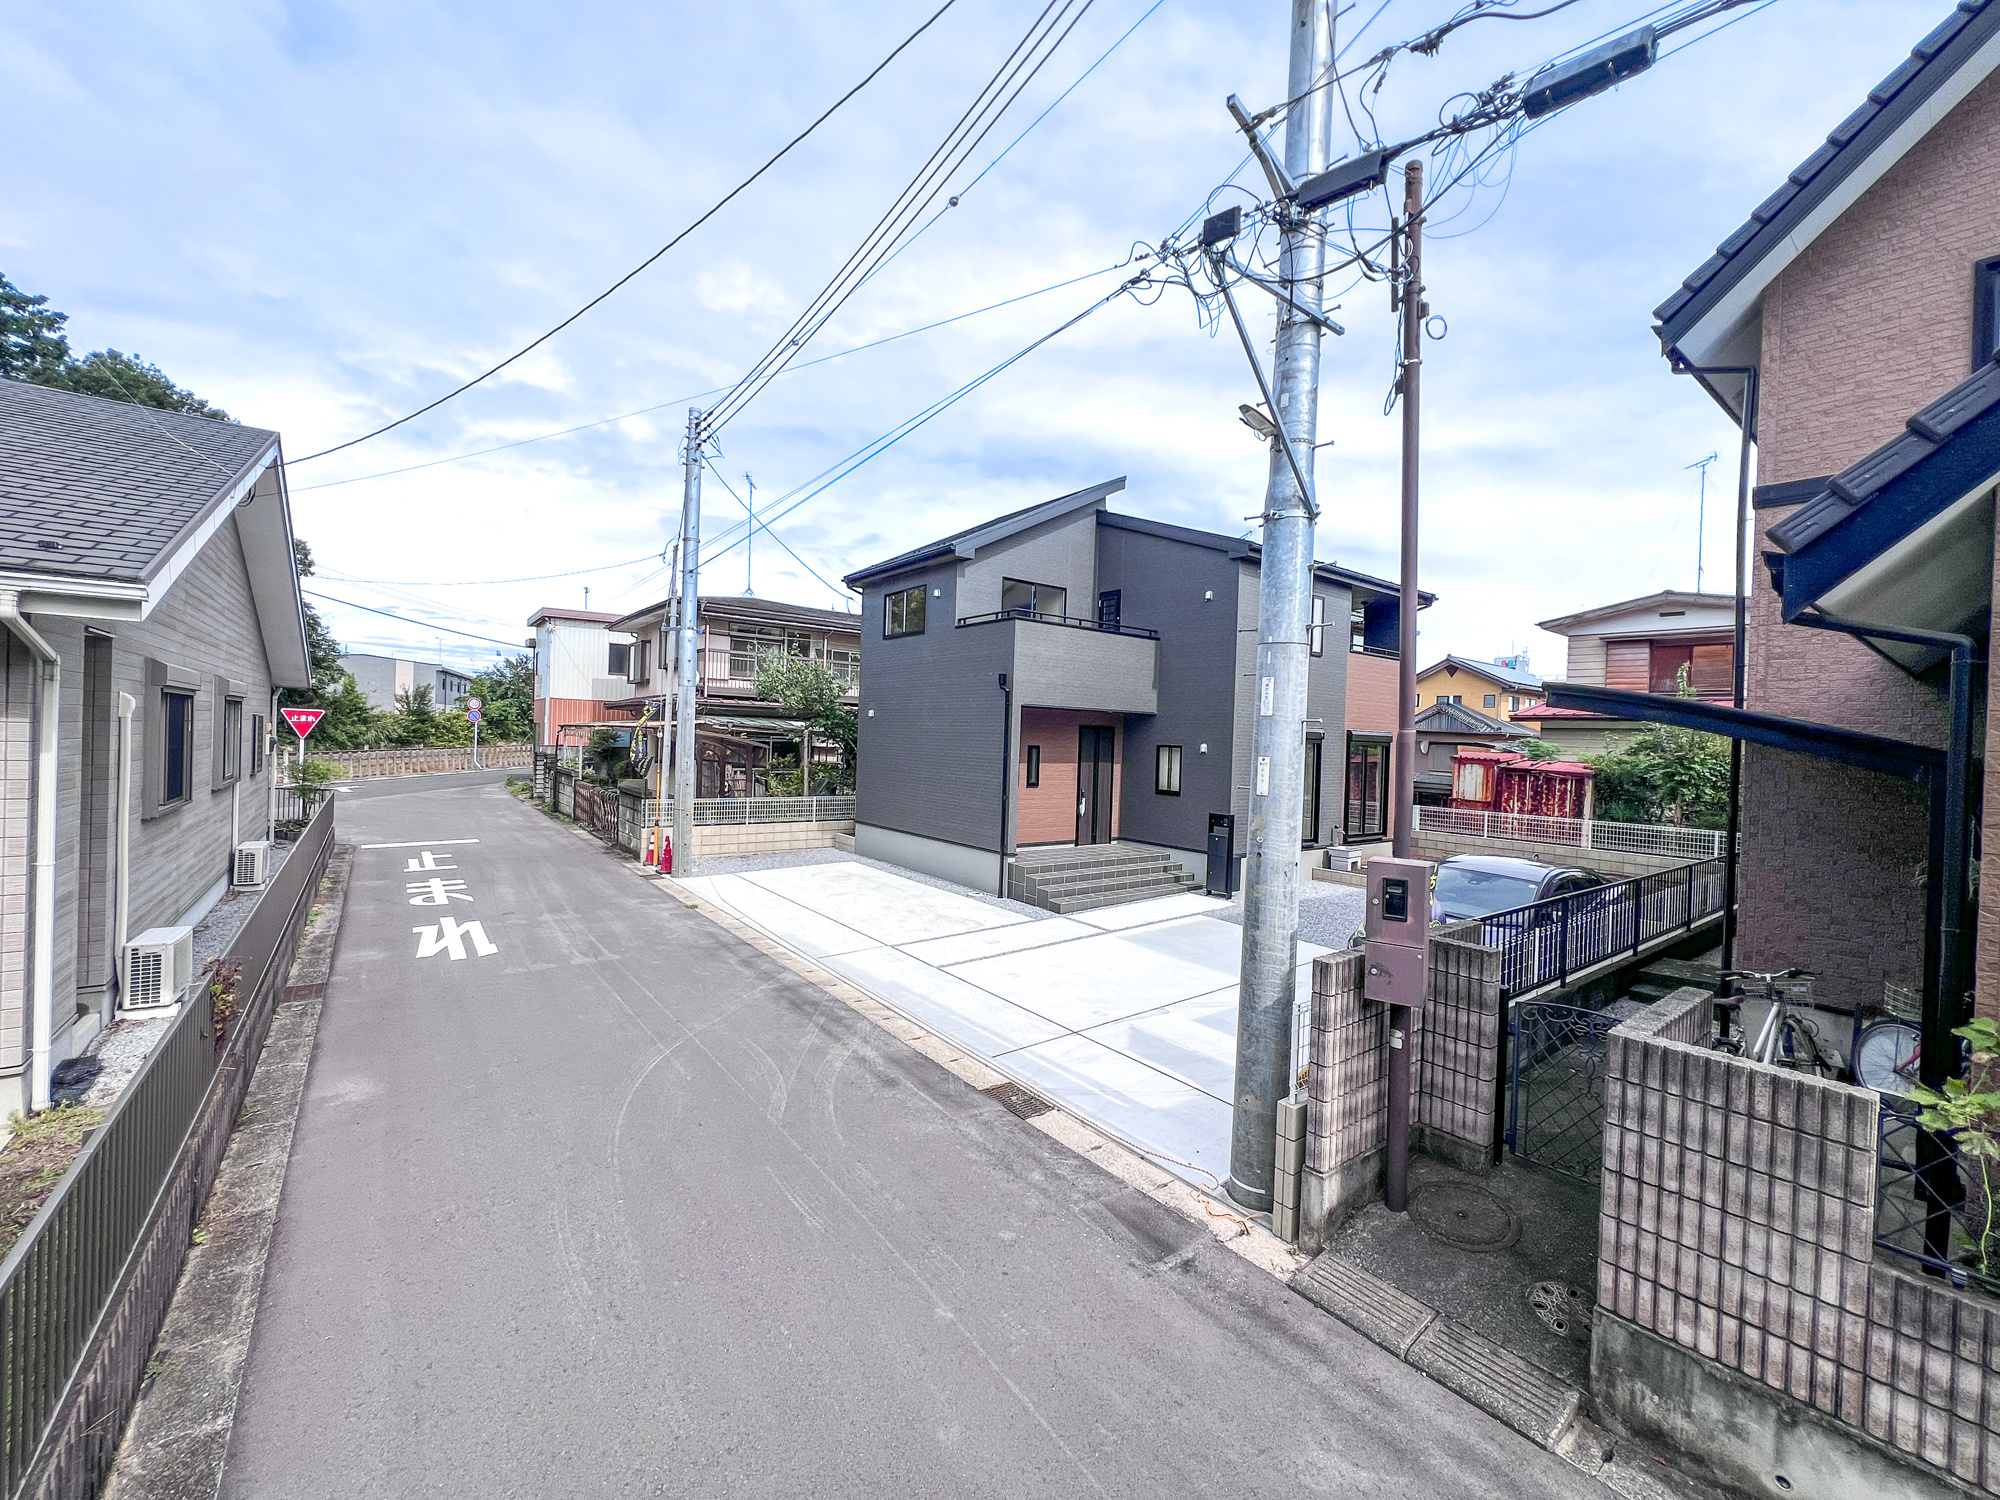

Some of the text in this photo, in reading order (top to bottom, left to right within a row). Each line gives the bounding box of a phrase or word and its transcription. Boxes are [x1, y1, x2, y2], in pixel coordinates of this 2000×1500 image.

[290, 714, 316, 722] 止まれ
[403, 850, 499, 961] 止まれ
